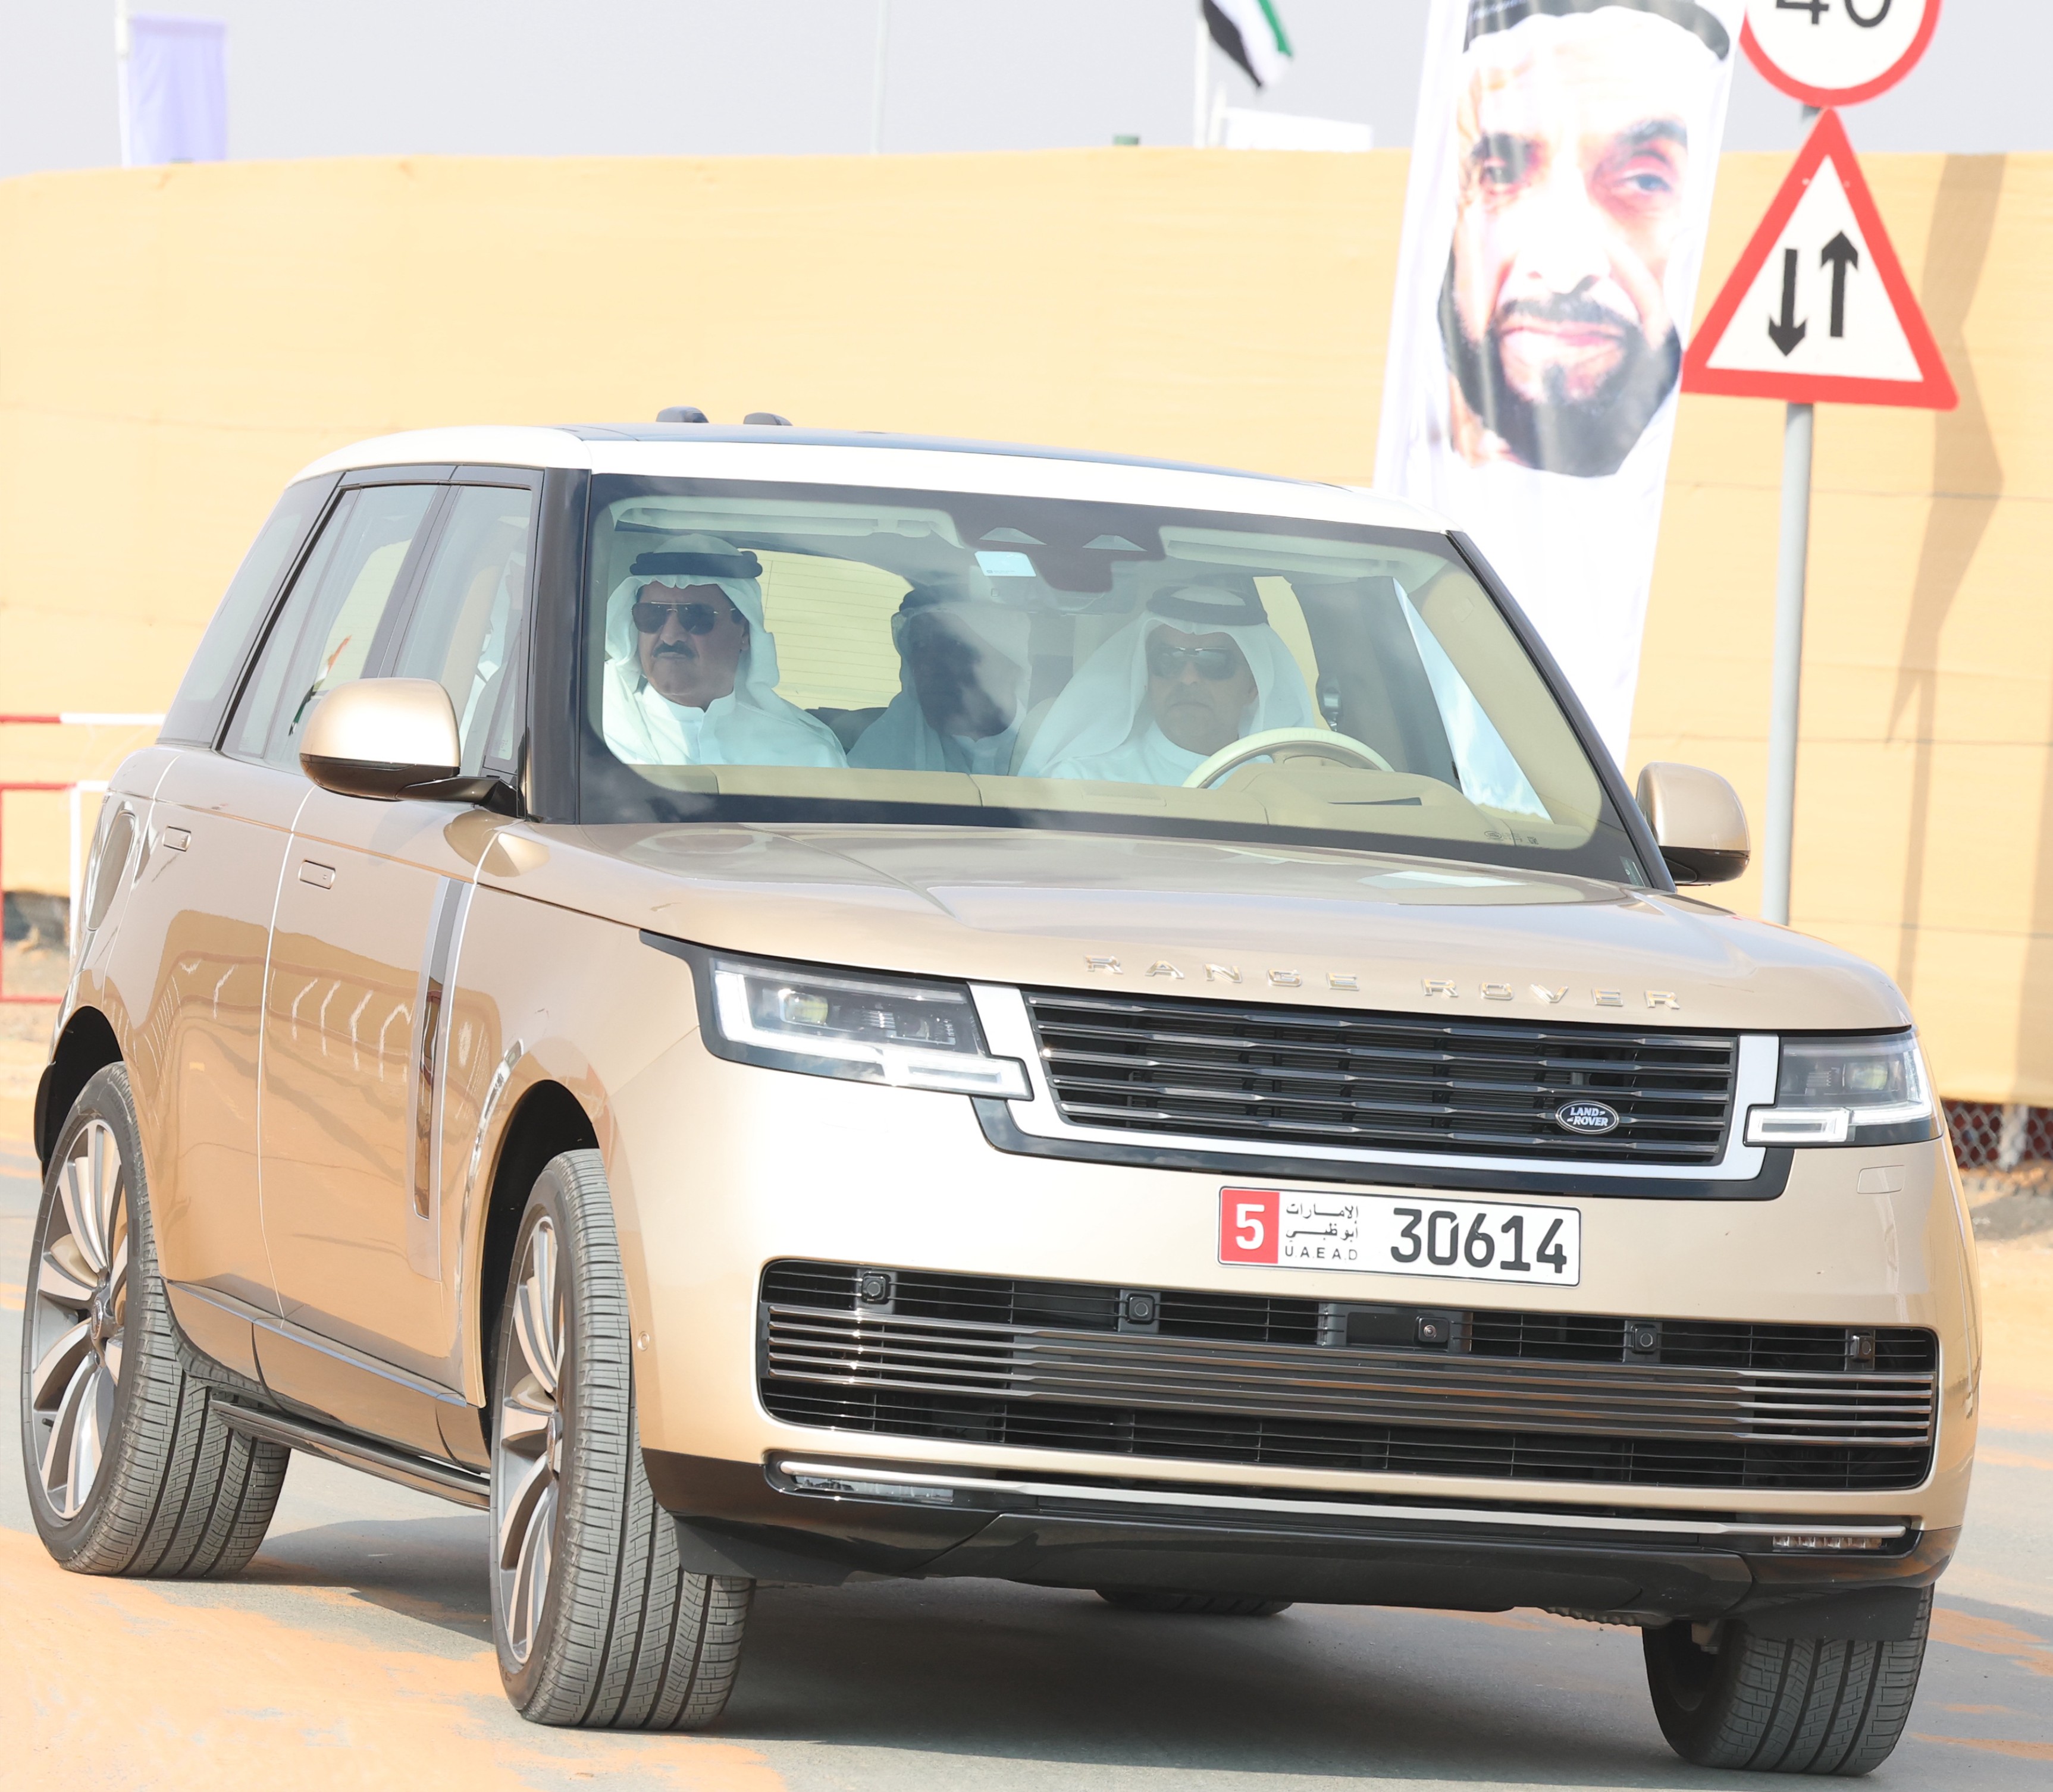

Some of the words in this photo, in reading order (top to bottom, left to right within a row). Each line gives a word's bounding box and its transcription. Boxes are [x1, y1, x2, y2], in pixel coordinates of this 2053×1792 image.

[1085, 954, 1361, 991] RANGE
[1421, 978, 1681, 1010] ROVER
[1570, 1107, 1599, 1116] LAND
[1573, 1116, 1609, 1126] ROVER
[1235, 1203, 1265, 1250] 5
[1390, 1207, 1568, 1274] 30614
